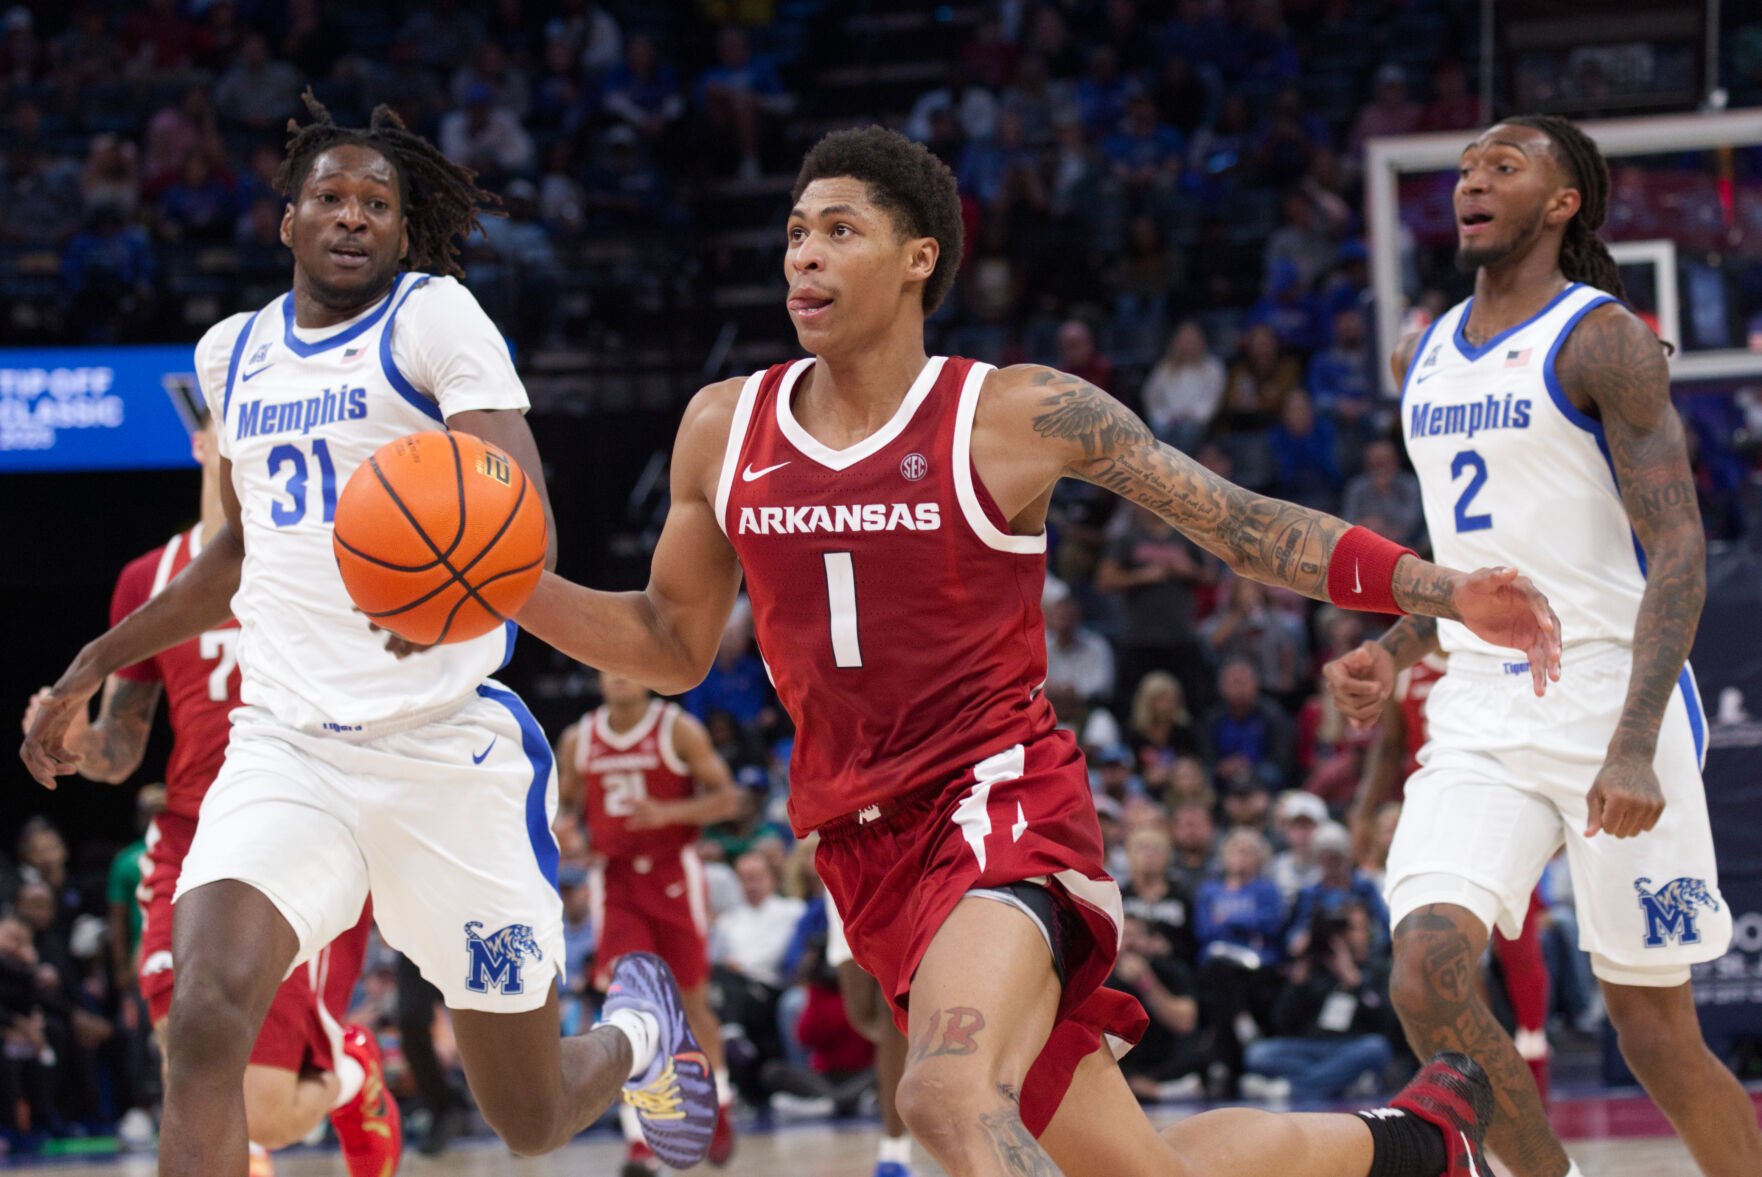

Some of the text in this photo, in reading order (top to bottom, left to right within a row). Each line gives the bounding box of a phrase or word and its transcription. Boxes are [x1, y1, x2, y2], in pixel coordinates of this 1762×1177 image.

[236, 384, 367, 441] Memphis
[1411, 393, 1532, 440] Memphis
[267, 438, 338, 527] 31
[902, 454, 925, 479] SEC
[1450, 449, 1493, 534] 2
[738, 502, 941, 535] ARKANSAS
[823, 551, 864, 668] 1
